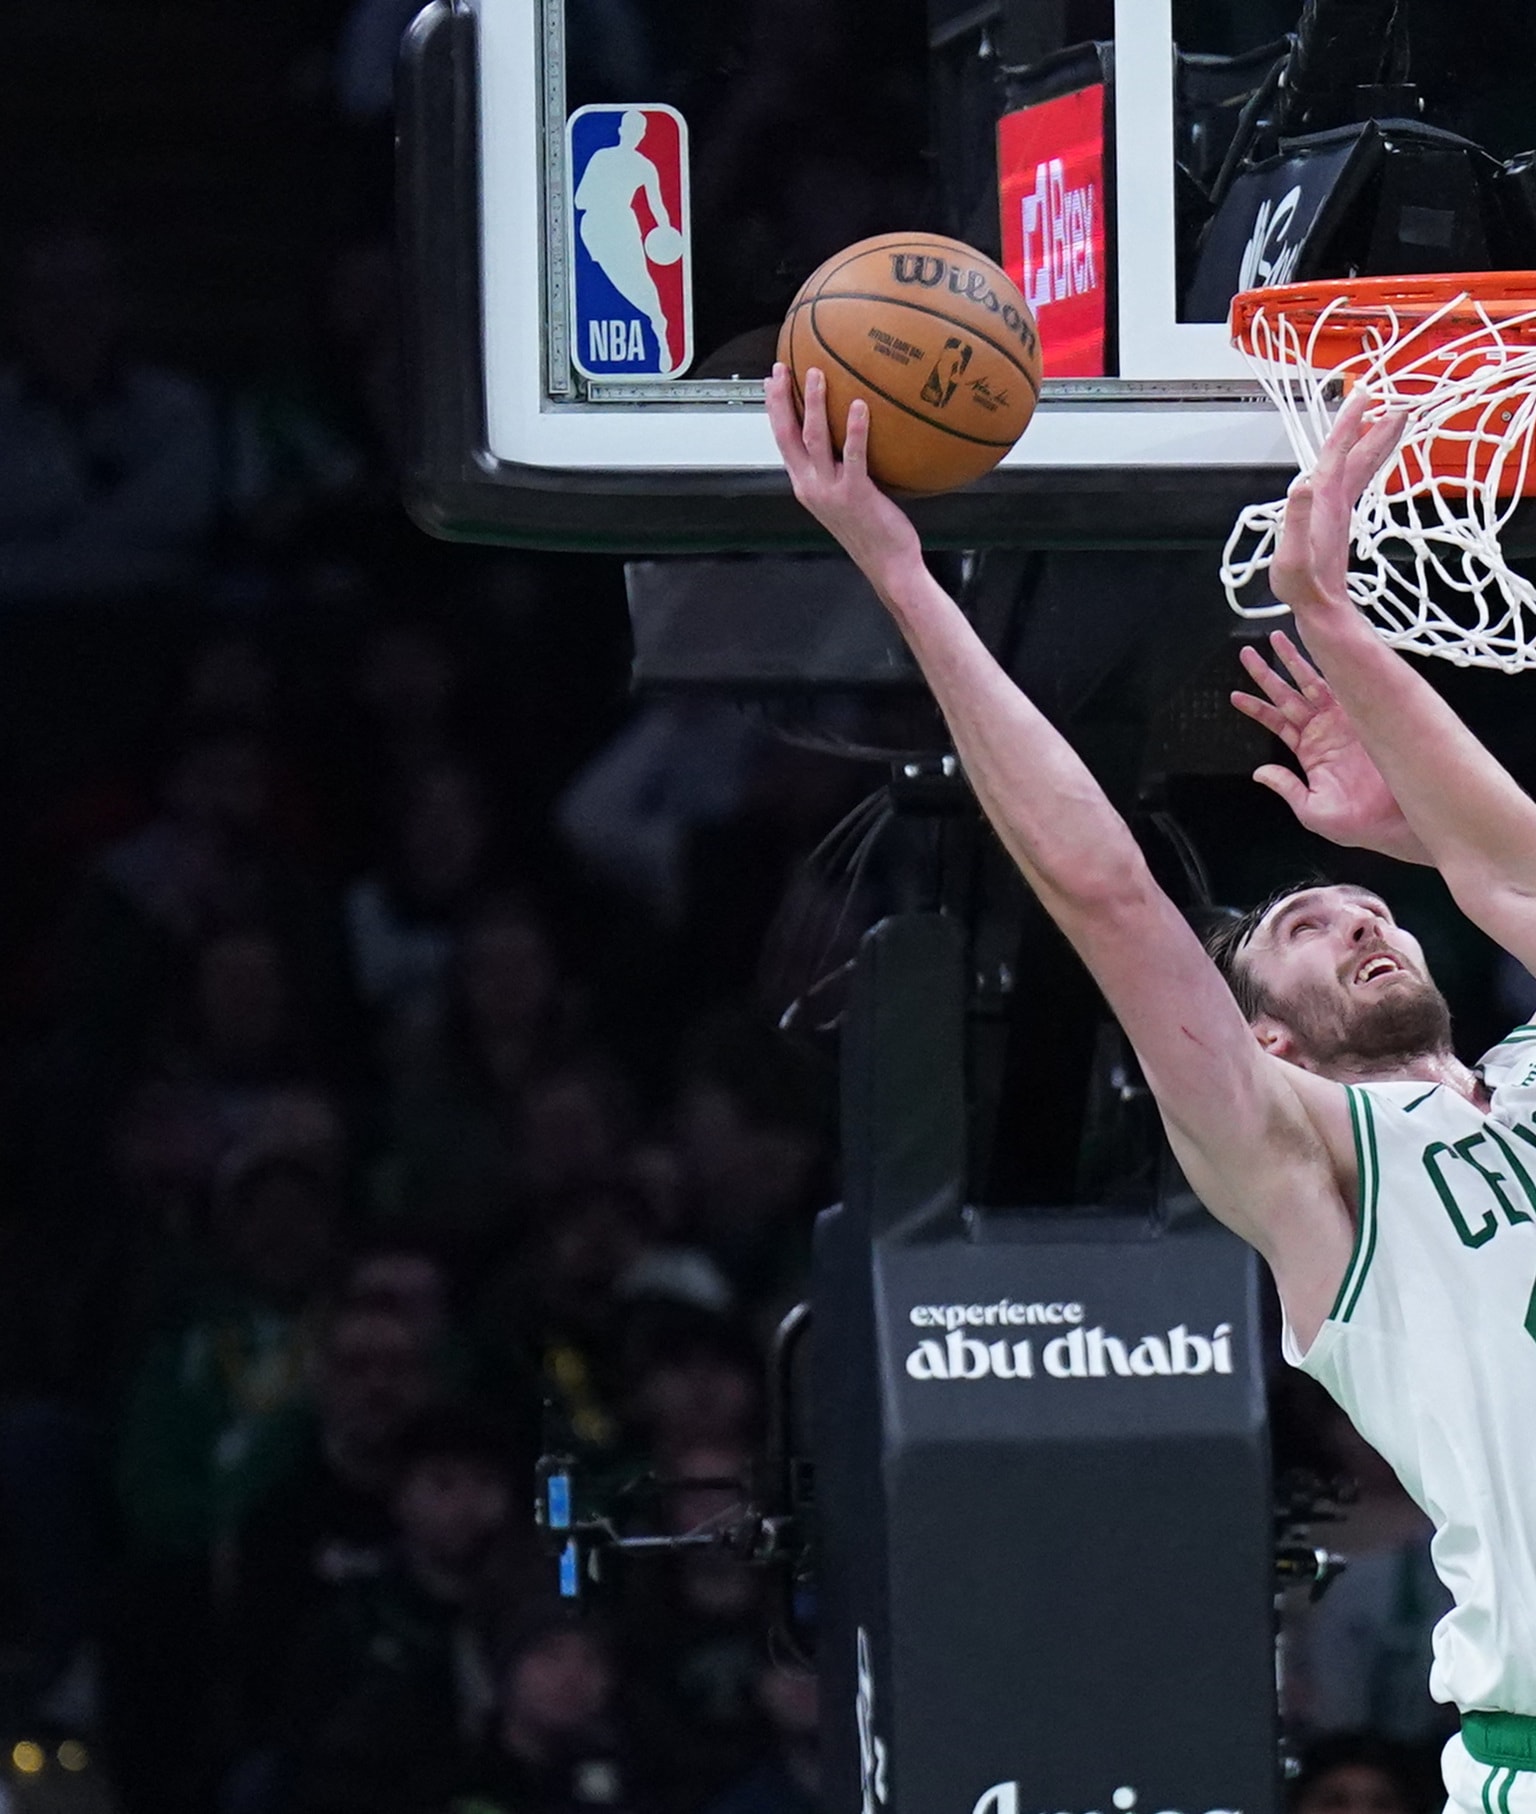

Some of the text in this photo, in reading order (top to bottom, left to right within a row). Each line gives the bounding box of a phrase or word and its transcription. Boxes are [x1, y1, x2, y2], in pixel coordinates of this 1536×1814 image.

[1049, 157, 1097, 301] Brex
[889, 254, 1036, 360] Wilson
[589, 319, 646, 362] NBA
[909, 1299, 1085, 1330] experience
[906, 1328, 1034, 1379] abu
